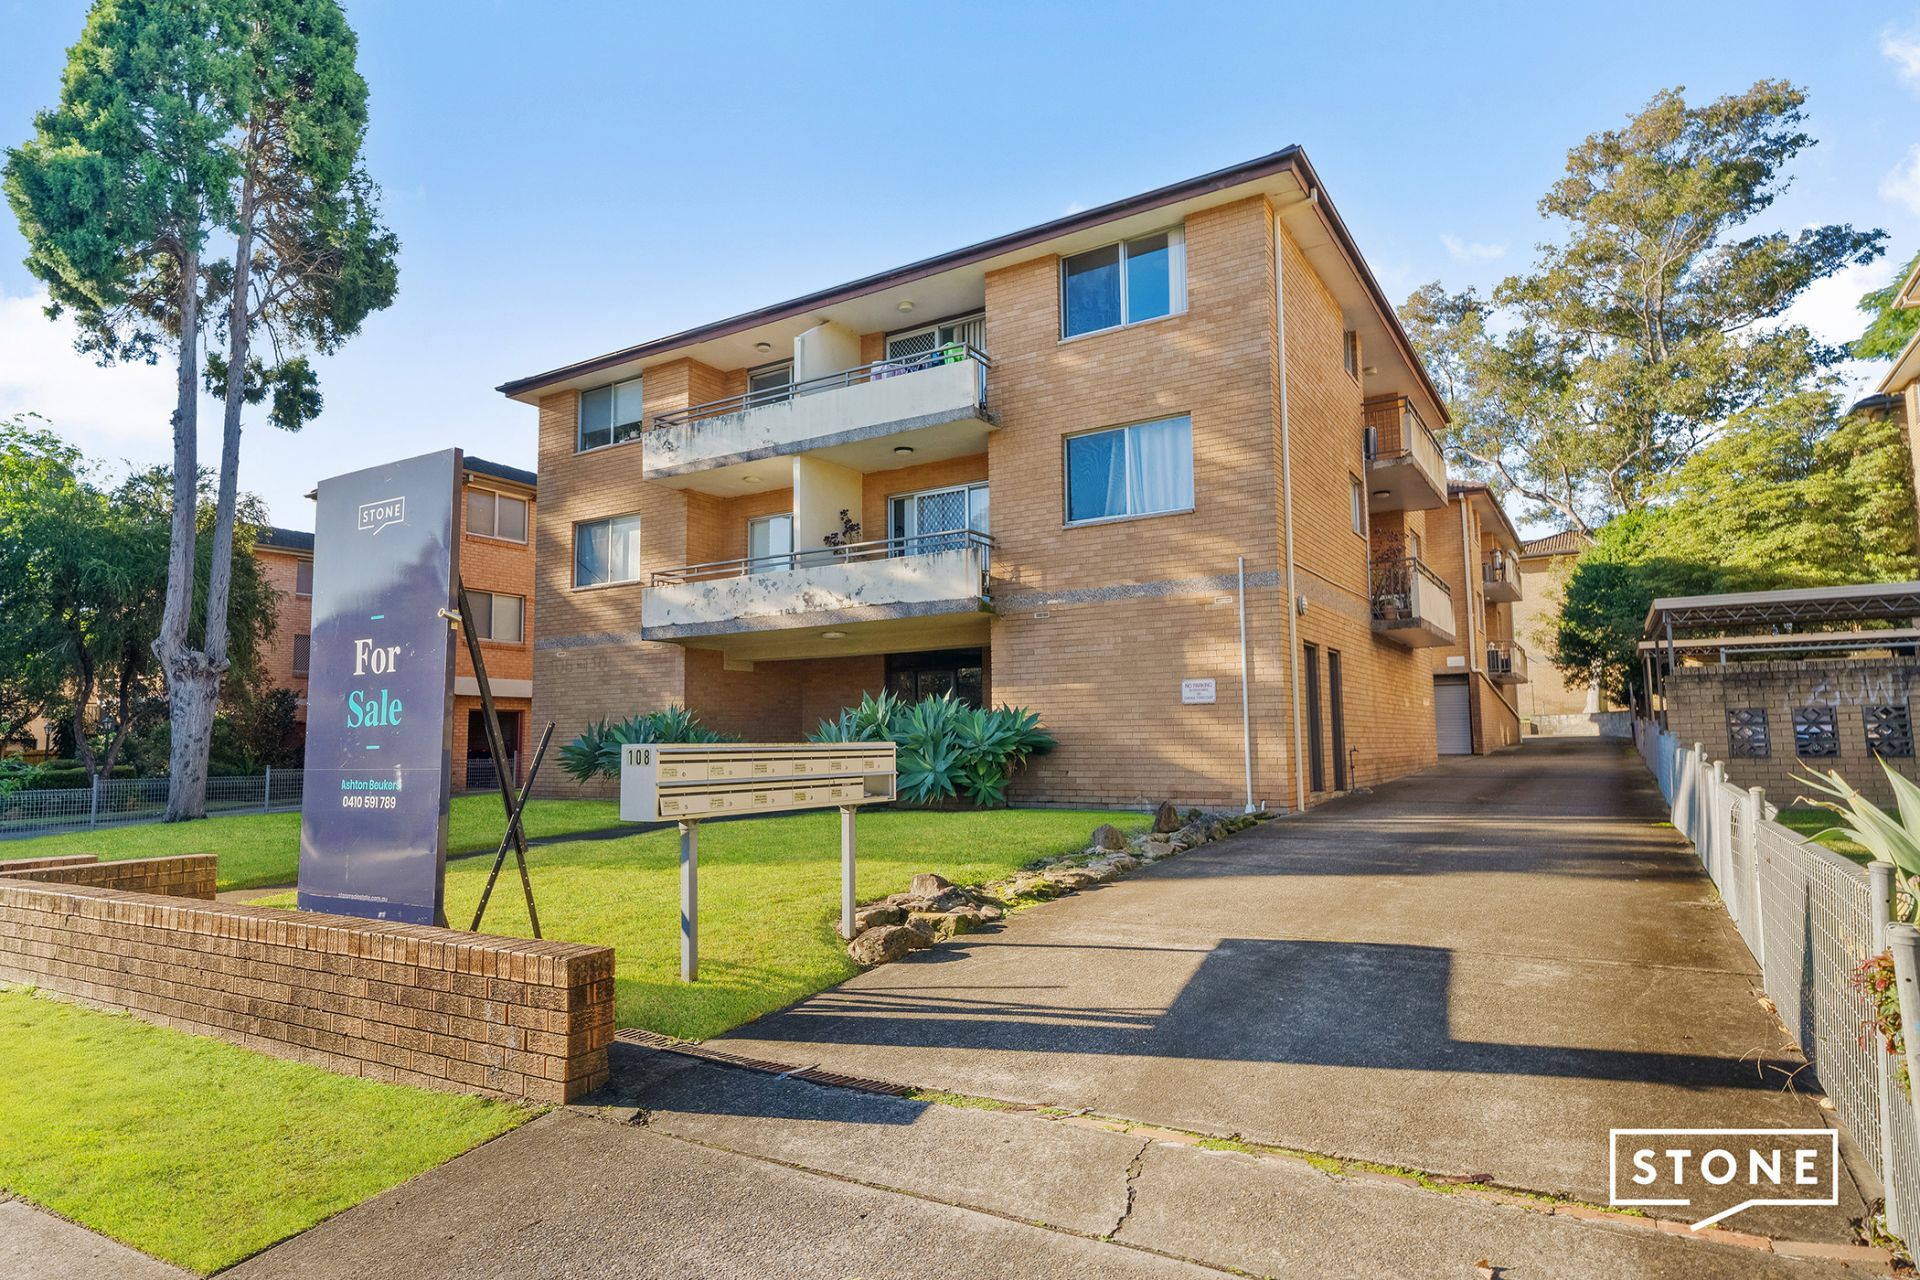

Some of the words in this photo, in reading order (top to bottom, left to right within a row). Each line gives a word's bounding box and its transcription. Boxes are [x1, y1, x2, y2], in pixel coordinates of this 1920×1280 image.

[362, 504, 401, 523] STONE
[353, 639, 401, 676] For
[346, 688, 402, 730] Sale
[628, 749, 651, 766] 108
[341, 779, 368, 790] Ashton
[369, 779, 401, 790] Beukers
[342, 795, 363, 808] 0410
[364, 796, 378, 808] 591
[379, 796, 396, 808] 789
